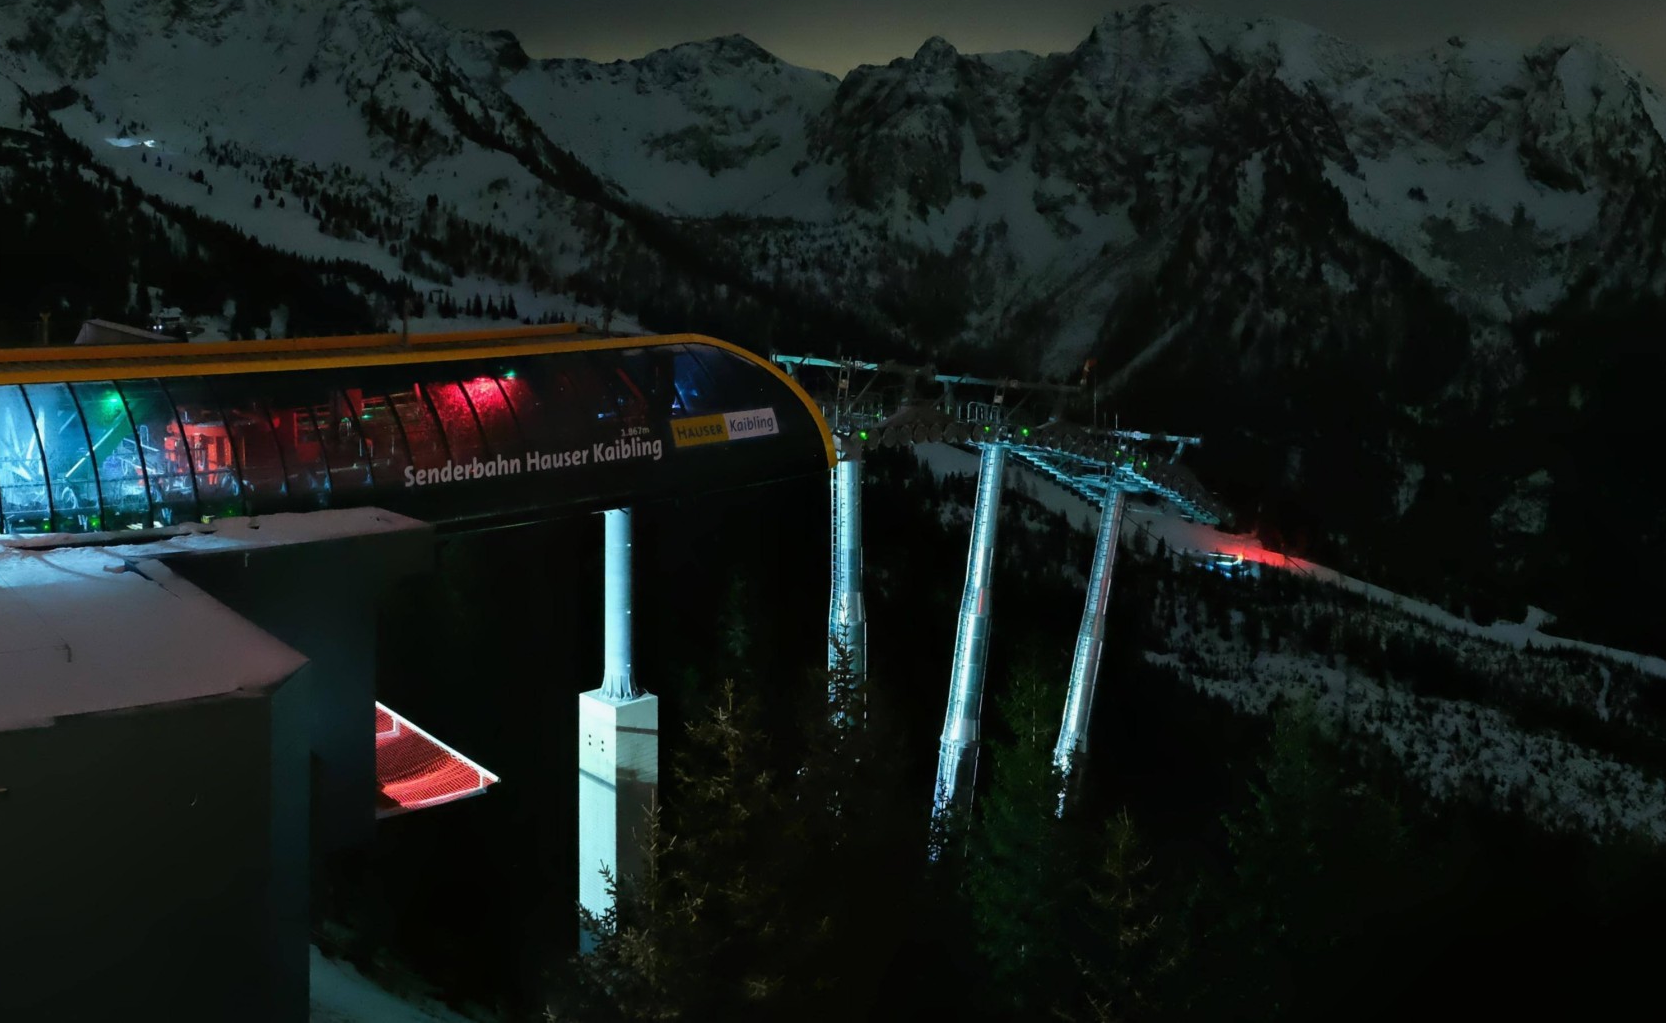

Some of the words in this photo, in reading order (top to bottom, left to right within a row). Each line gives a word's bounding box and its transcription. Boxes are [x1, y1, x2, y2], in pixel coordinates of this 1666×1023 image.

[677, 423, 723, 440] HAUSER
[729, 415, 773, 433] Kaibling
[404, 455, 521, 487] Senderbahn
[527, 447, 589, 472] Hauser
[593, 439, 662, 463] Kaibling
